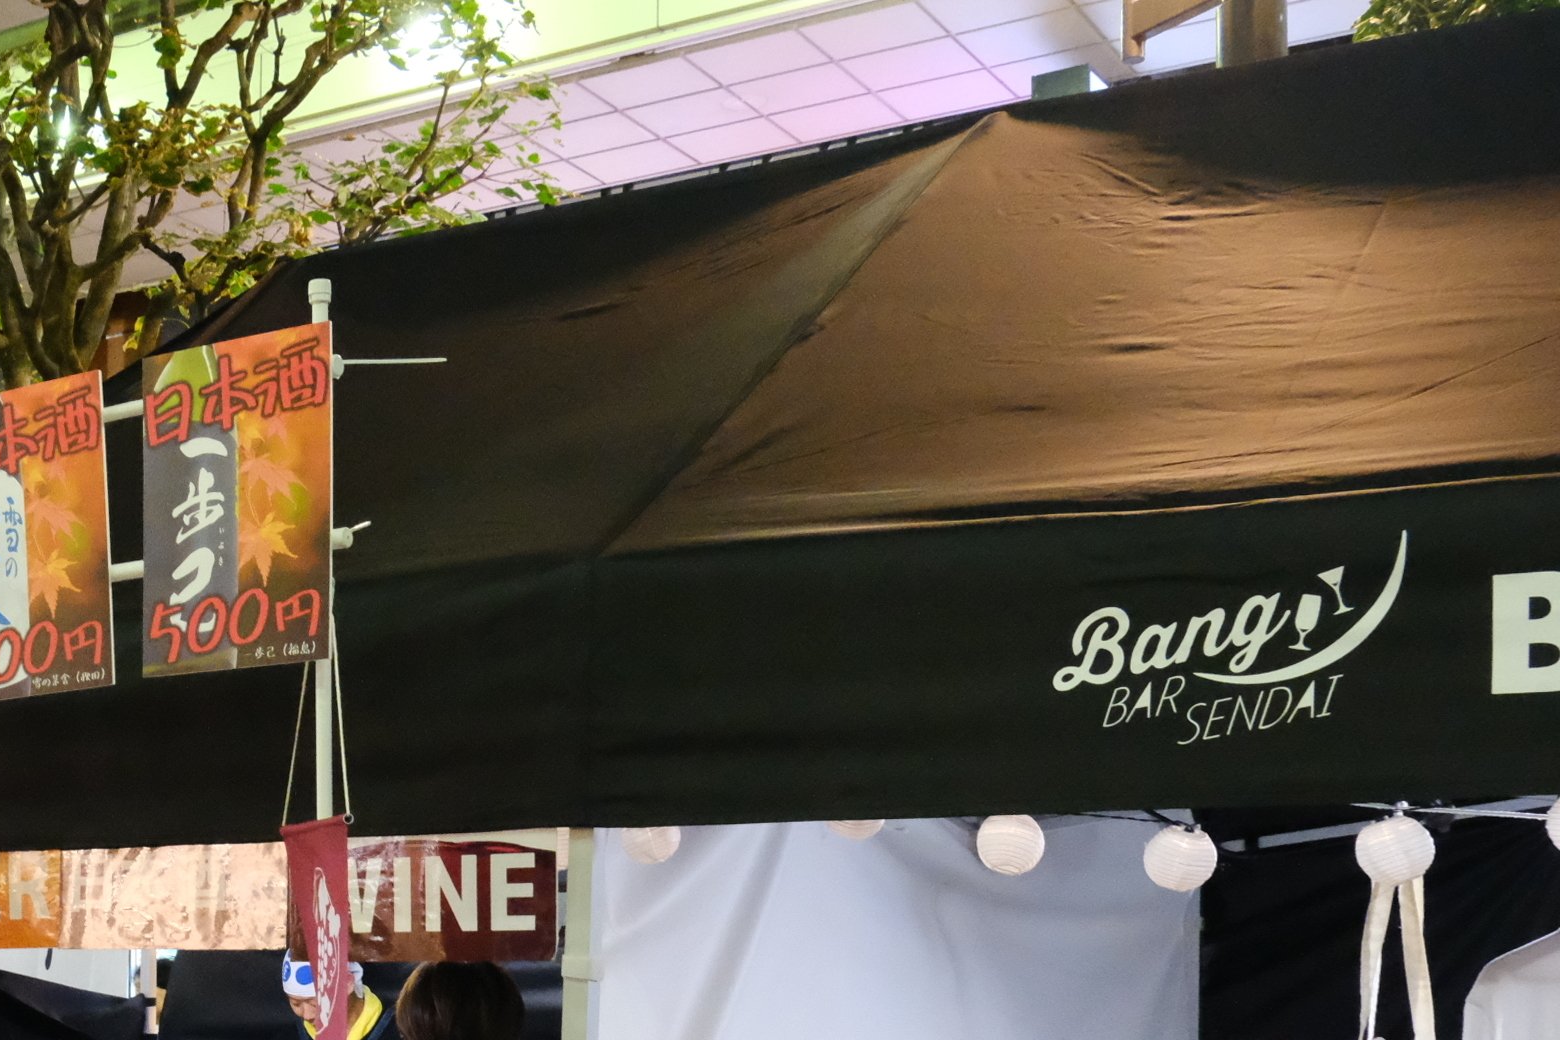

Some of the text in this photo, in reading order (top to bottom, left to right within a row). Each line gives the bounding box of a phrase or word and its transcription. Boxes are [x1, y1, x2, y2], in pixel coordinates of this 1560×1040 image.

[144, 337, 331, 449] 日本酒
[149, 587, 322, 664] 500円
[1052, 591, 1292, 692] Bang
[1102, 675, 1187, 729] BAR
[1177, 673, 1344, 746] SENDAI
